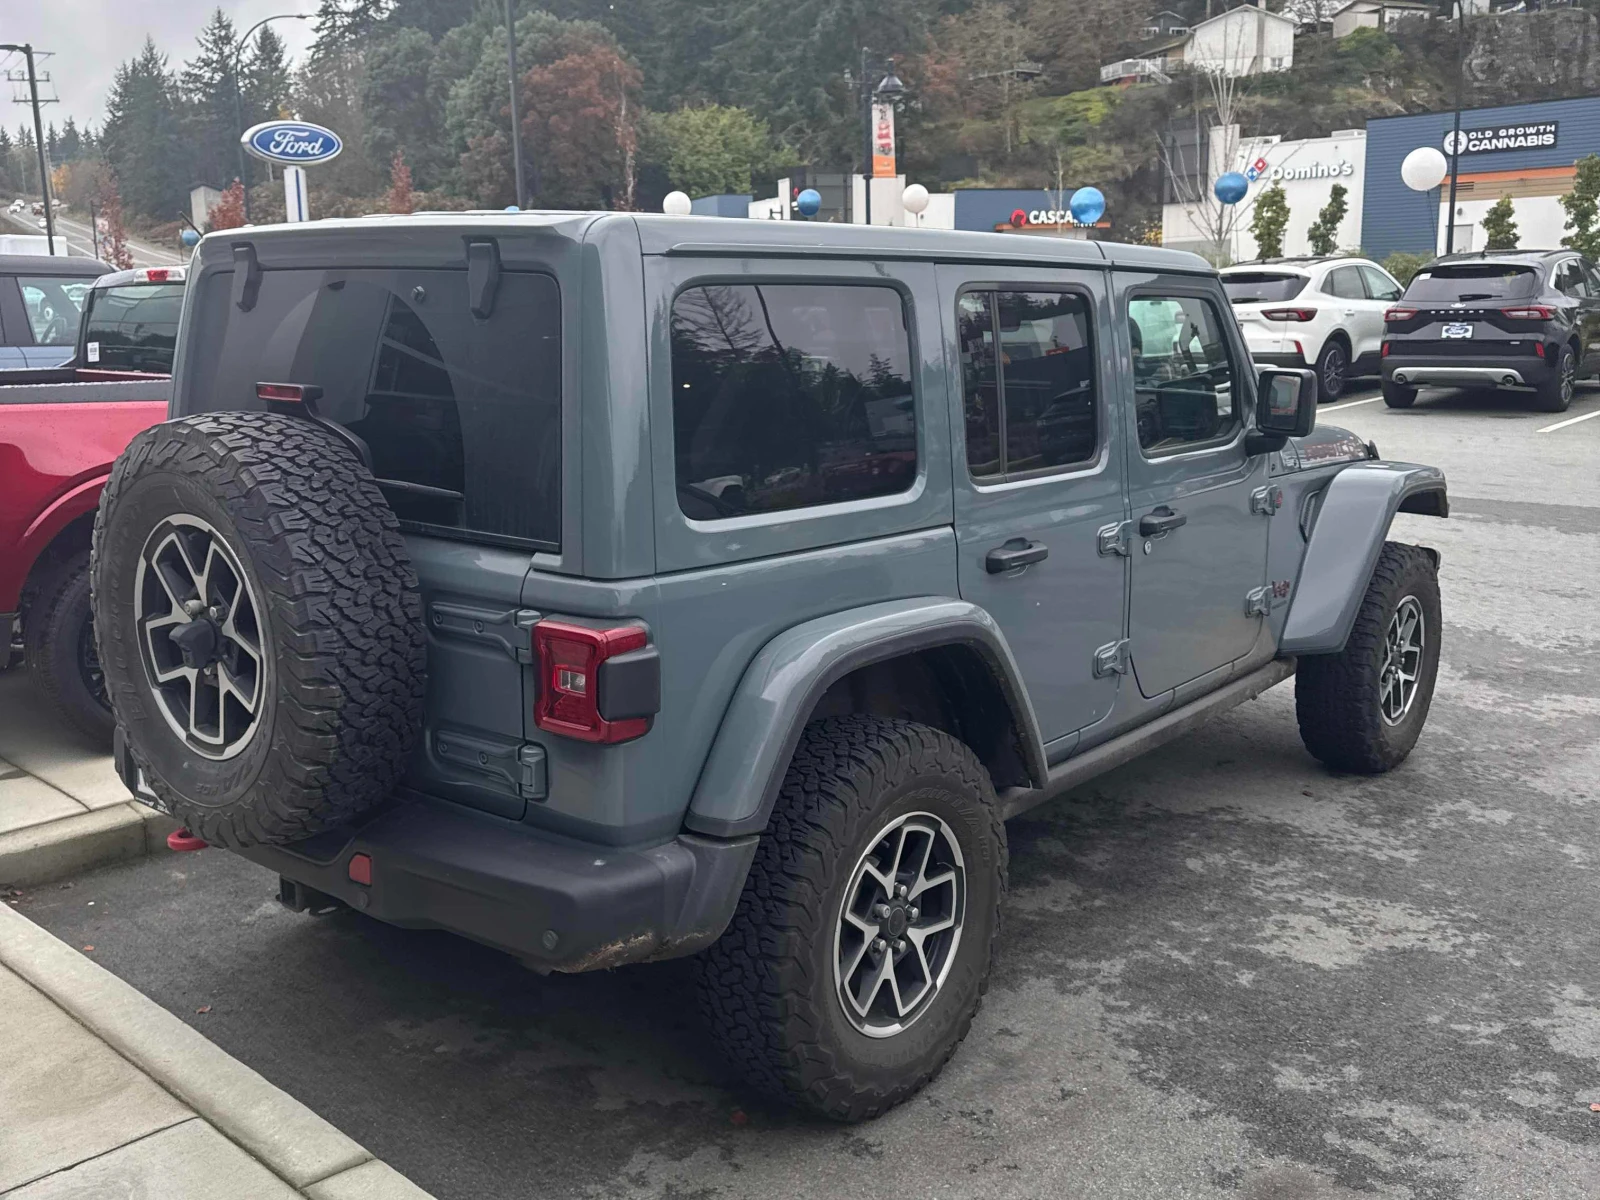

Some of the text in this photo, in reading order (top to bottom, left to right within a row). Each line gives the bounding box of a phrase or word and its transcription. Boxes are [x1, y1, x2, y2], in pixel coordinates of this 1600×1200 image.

[1469, 125, 1555, 139] OLD GROWTH
[269, 130, 323, 154] Ford
[1468, 134, 1555, 151] CANNABIS
[1271, 160, 1353, 180] Domino's
[1029, 210, 1079, 224] CASCA
